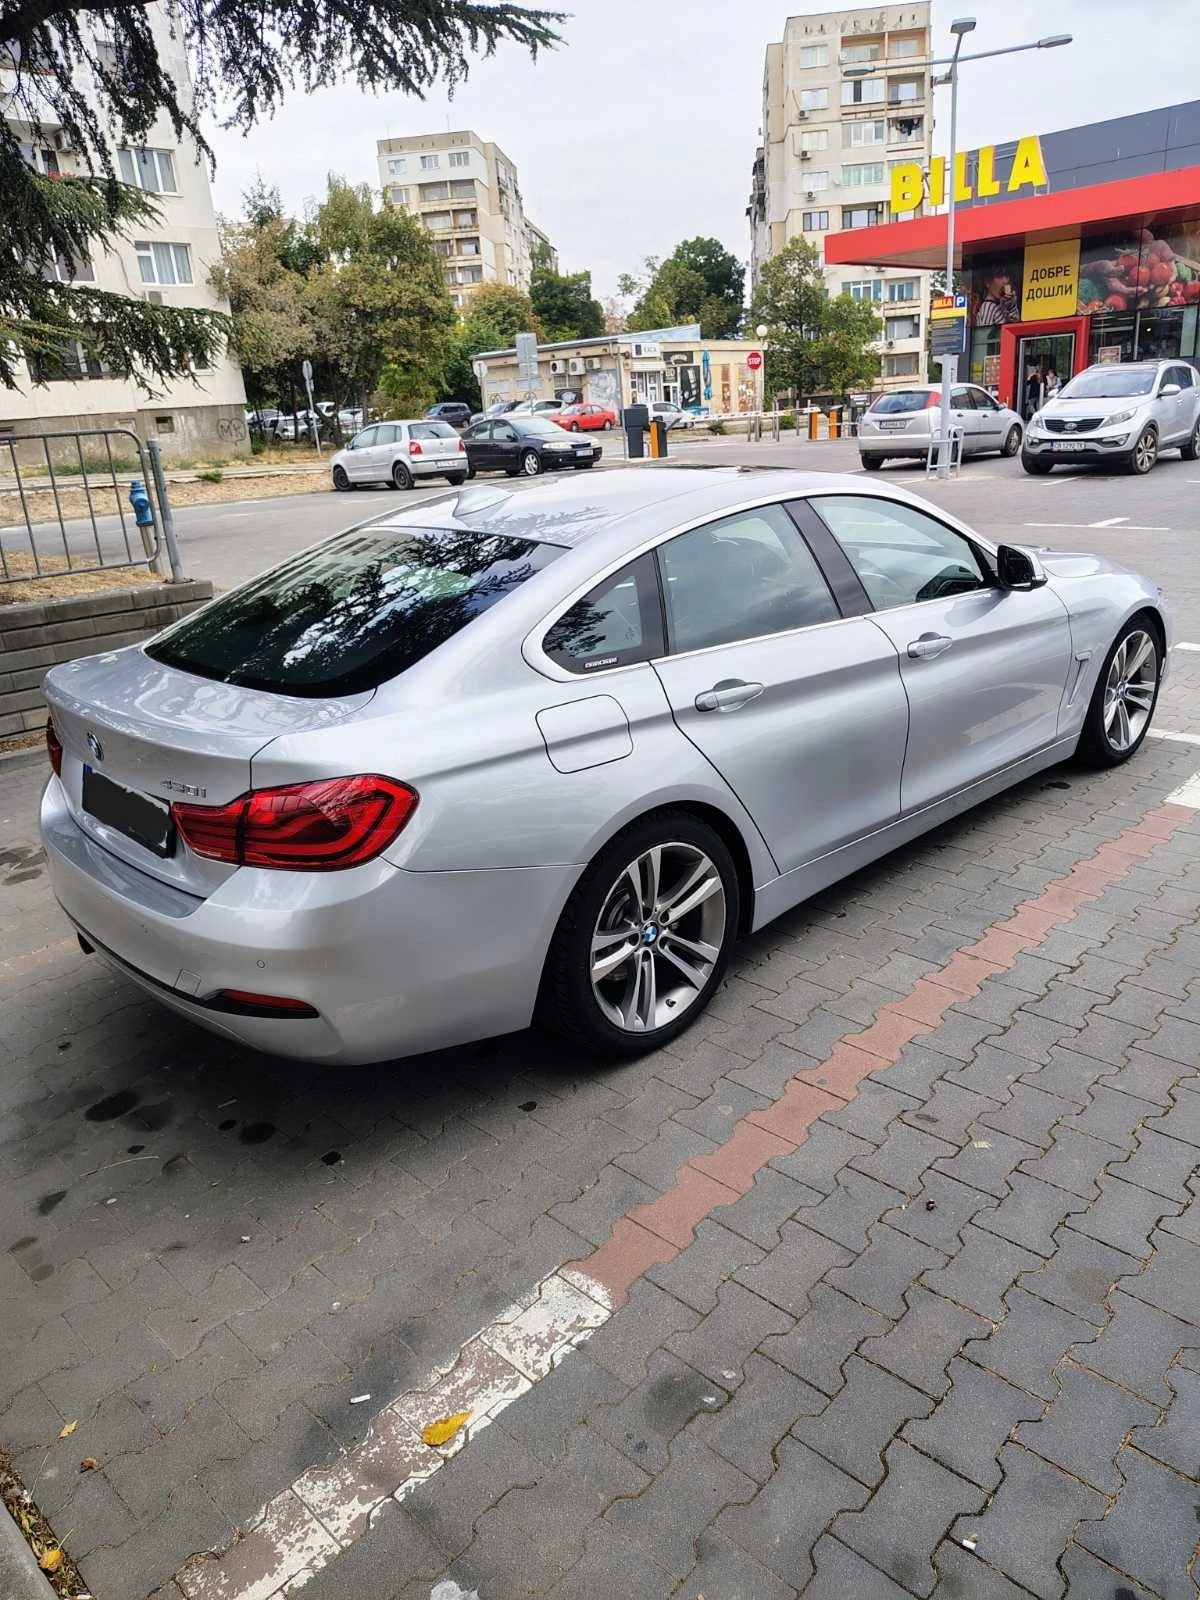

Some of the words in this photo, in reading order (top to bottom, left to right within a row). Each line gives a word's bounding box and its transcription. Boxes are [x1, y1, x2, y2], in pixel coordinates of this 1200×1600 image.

[890, 135, 1048, 214] BILLA
[1030, 265, 1072, 283] ДОБРЕ
[956, 296, 965, 307] P
[1026, 284, 1073, 302] ДОШЛИ
[748, 357, 761, 365] STOP
